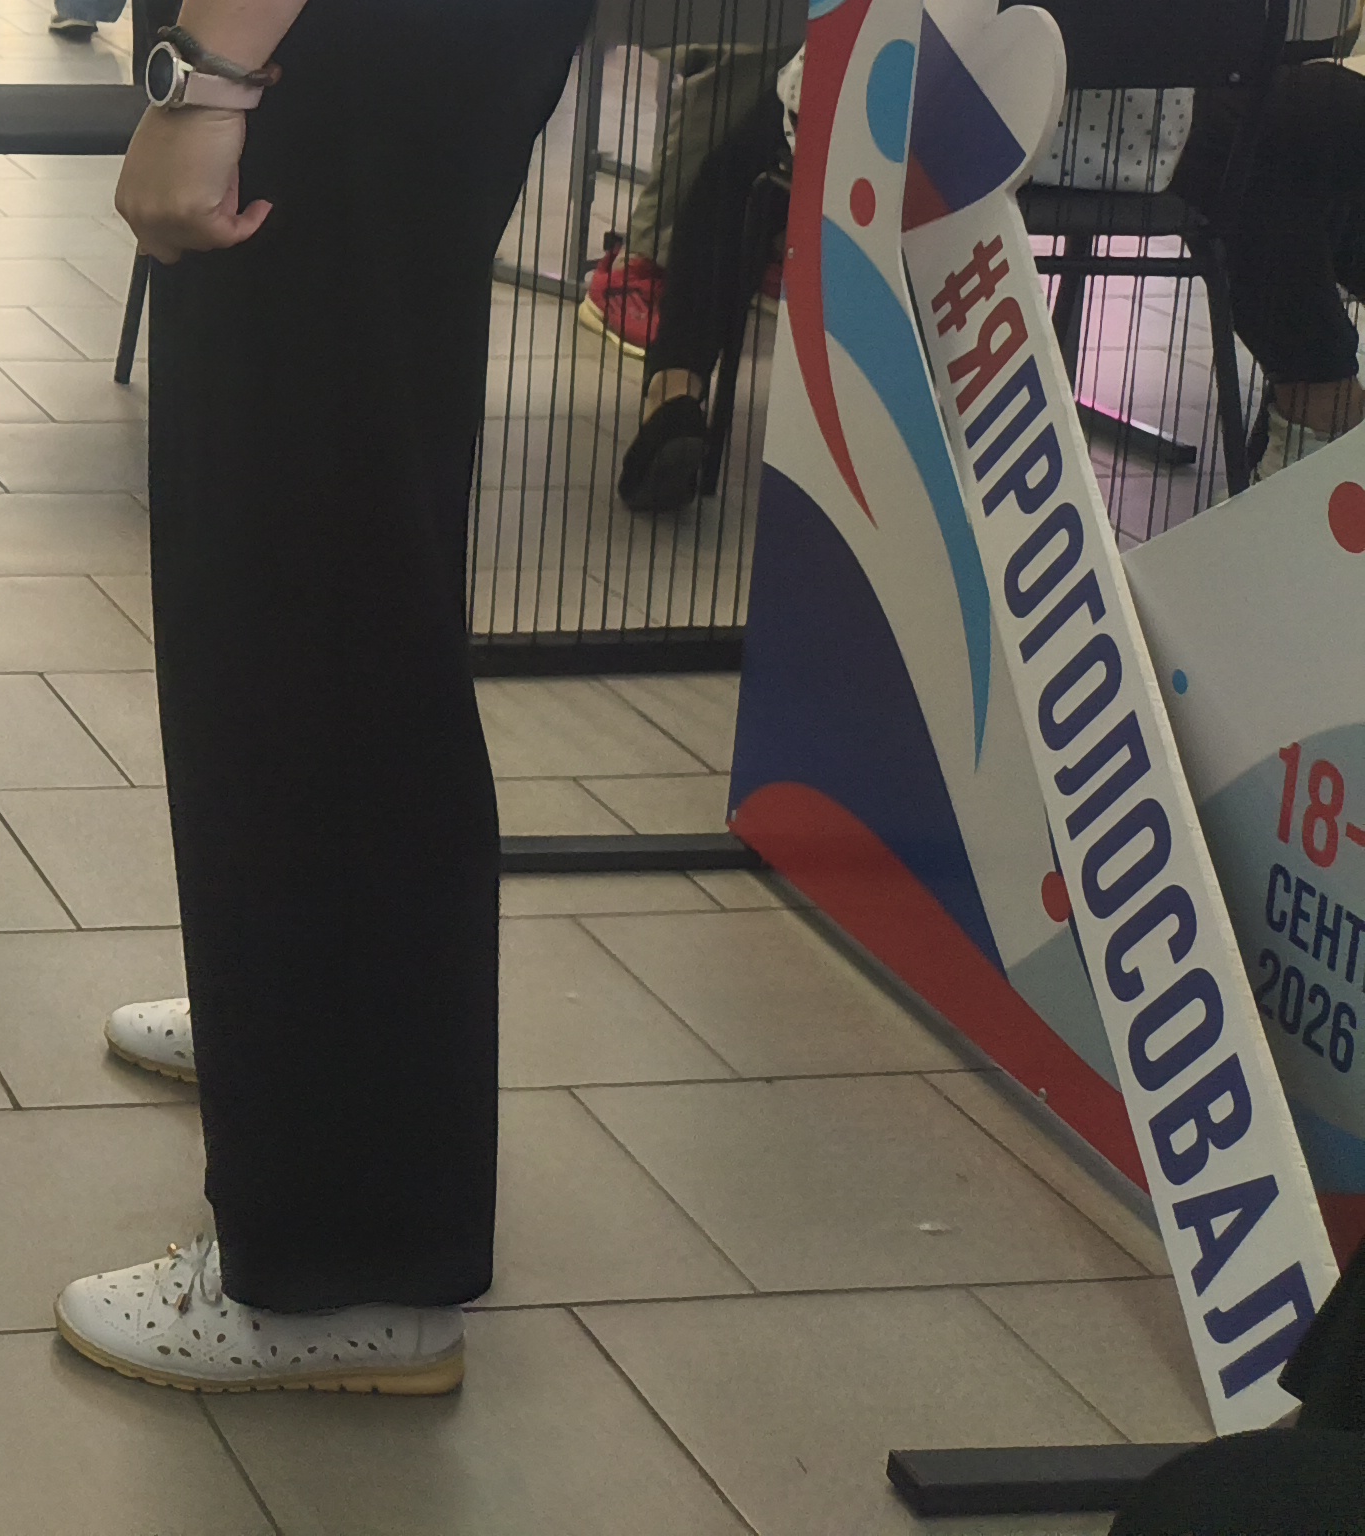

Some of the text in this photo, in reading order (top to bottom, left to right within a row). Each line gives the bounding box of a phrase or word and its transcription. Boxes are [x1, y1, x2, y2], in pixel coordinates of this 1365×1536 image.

[931, 235, 1316, 1399] #ЯПРОГОЛОСОВАЛ
[1266, 863, 1365, 993] СЕНТ
[1256, 948, 1357, 1073] 2026
